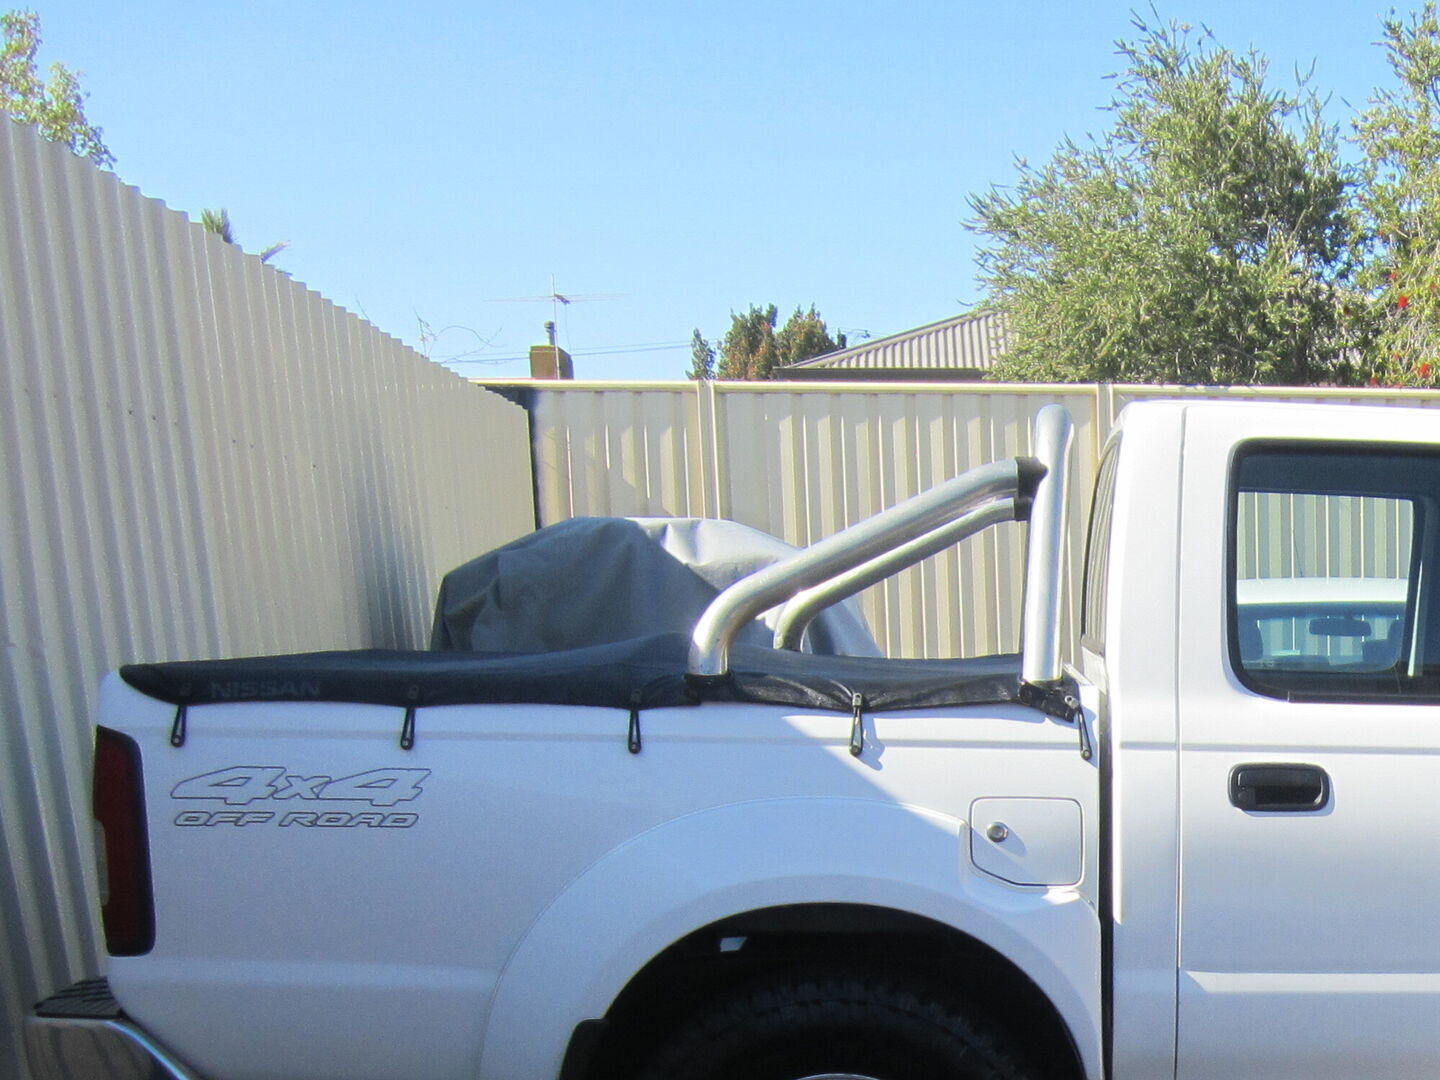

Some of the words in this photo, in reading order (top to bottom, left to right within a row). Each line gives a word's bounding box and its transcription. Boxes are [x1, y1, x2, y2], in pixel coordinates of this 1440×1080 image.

[211, 680, 321, 699] NISSAN
[171, 766, 432, 807] 4x4
[174, 811, 275, 827] OFF
[279, 812, 419, 828] ROAD
